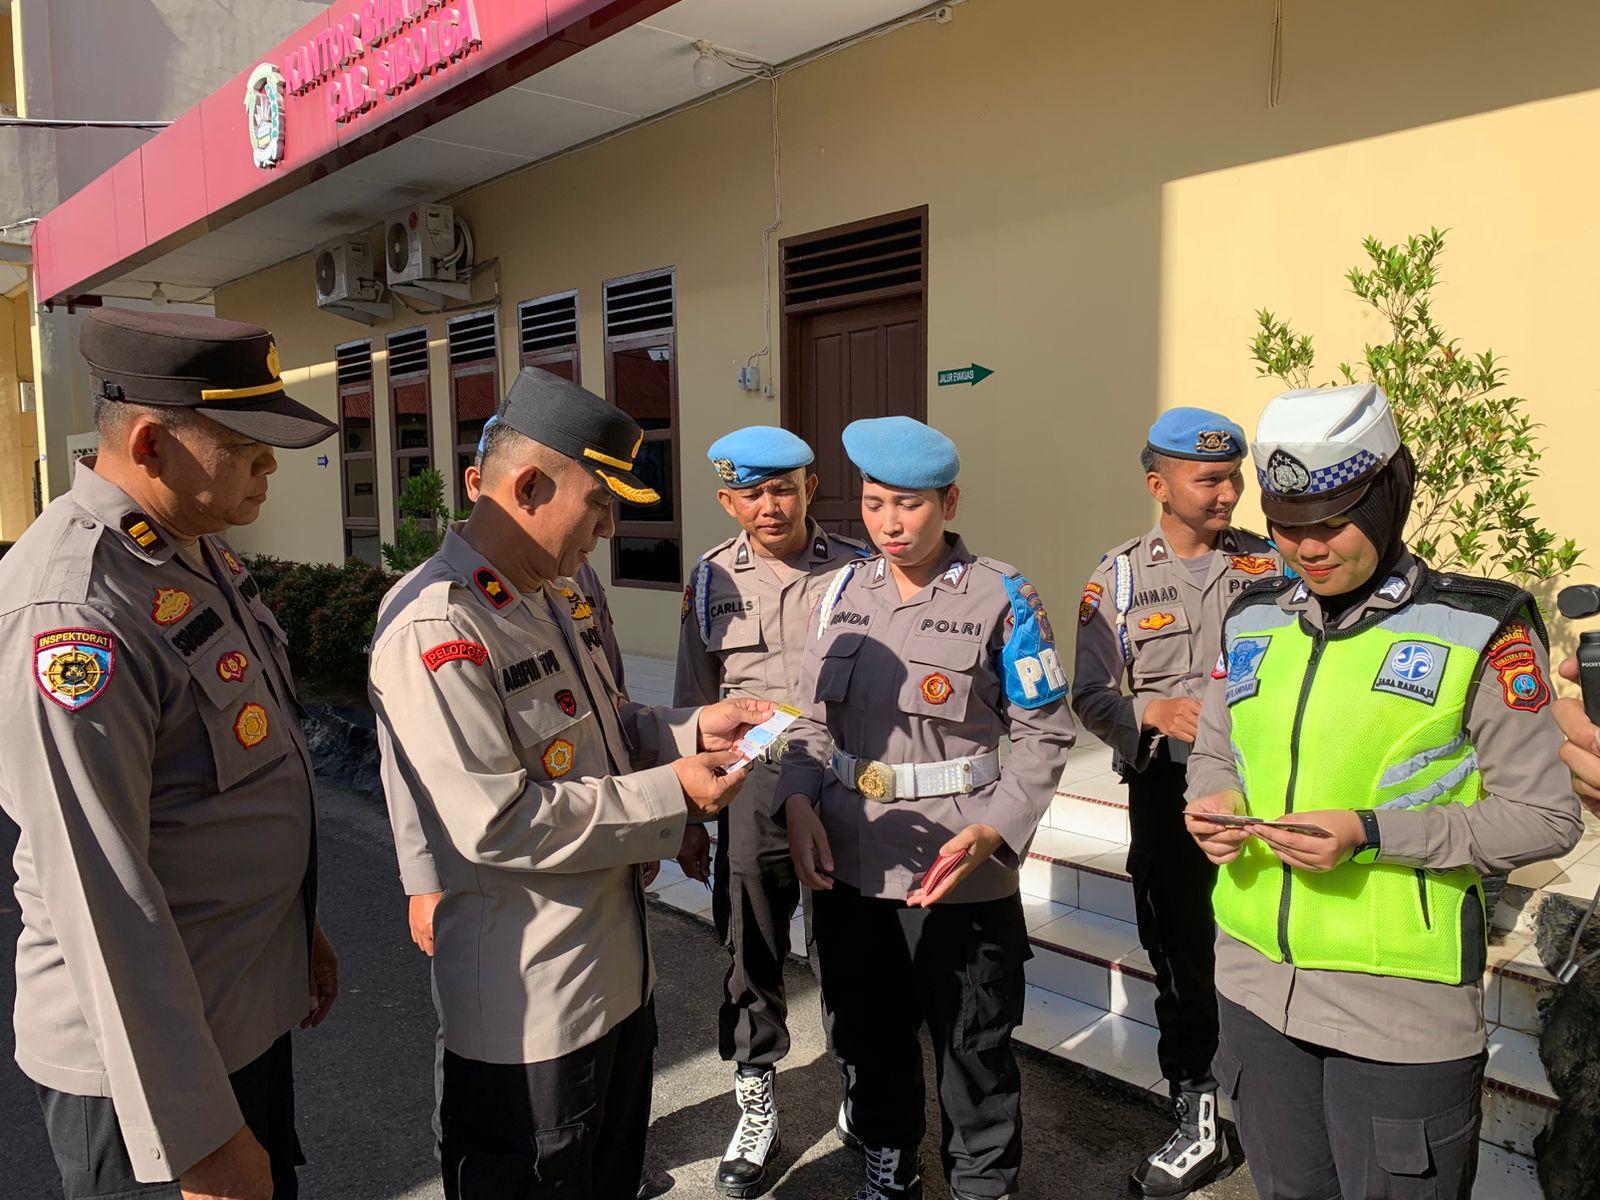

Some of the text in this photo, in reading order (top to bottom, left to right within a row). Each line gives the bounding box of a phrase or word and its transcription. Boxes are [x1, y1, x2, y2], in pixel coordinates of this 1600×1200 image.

[284, 12, 363, 94] KANTOR
[326, 65, 377, 122] CAB.
[374, 0, 477, 94] SIBOLGA
[1133, 585, 1178, 609] AHMAD
[920, 618, 982, 636] POLRI
[39, 632, 109, 647] INSPEKTORAT
[1376, 678, 1434, 698] JASA RAHARJA
